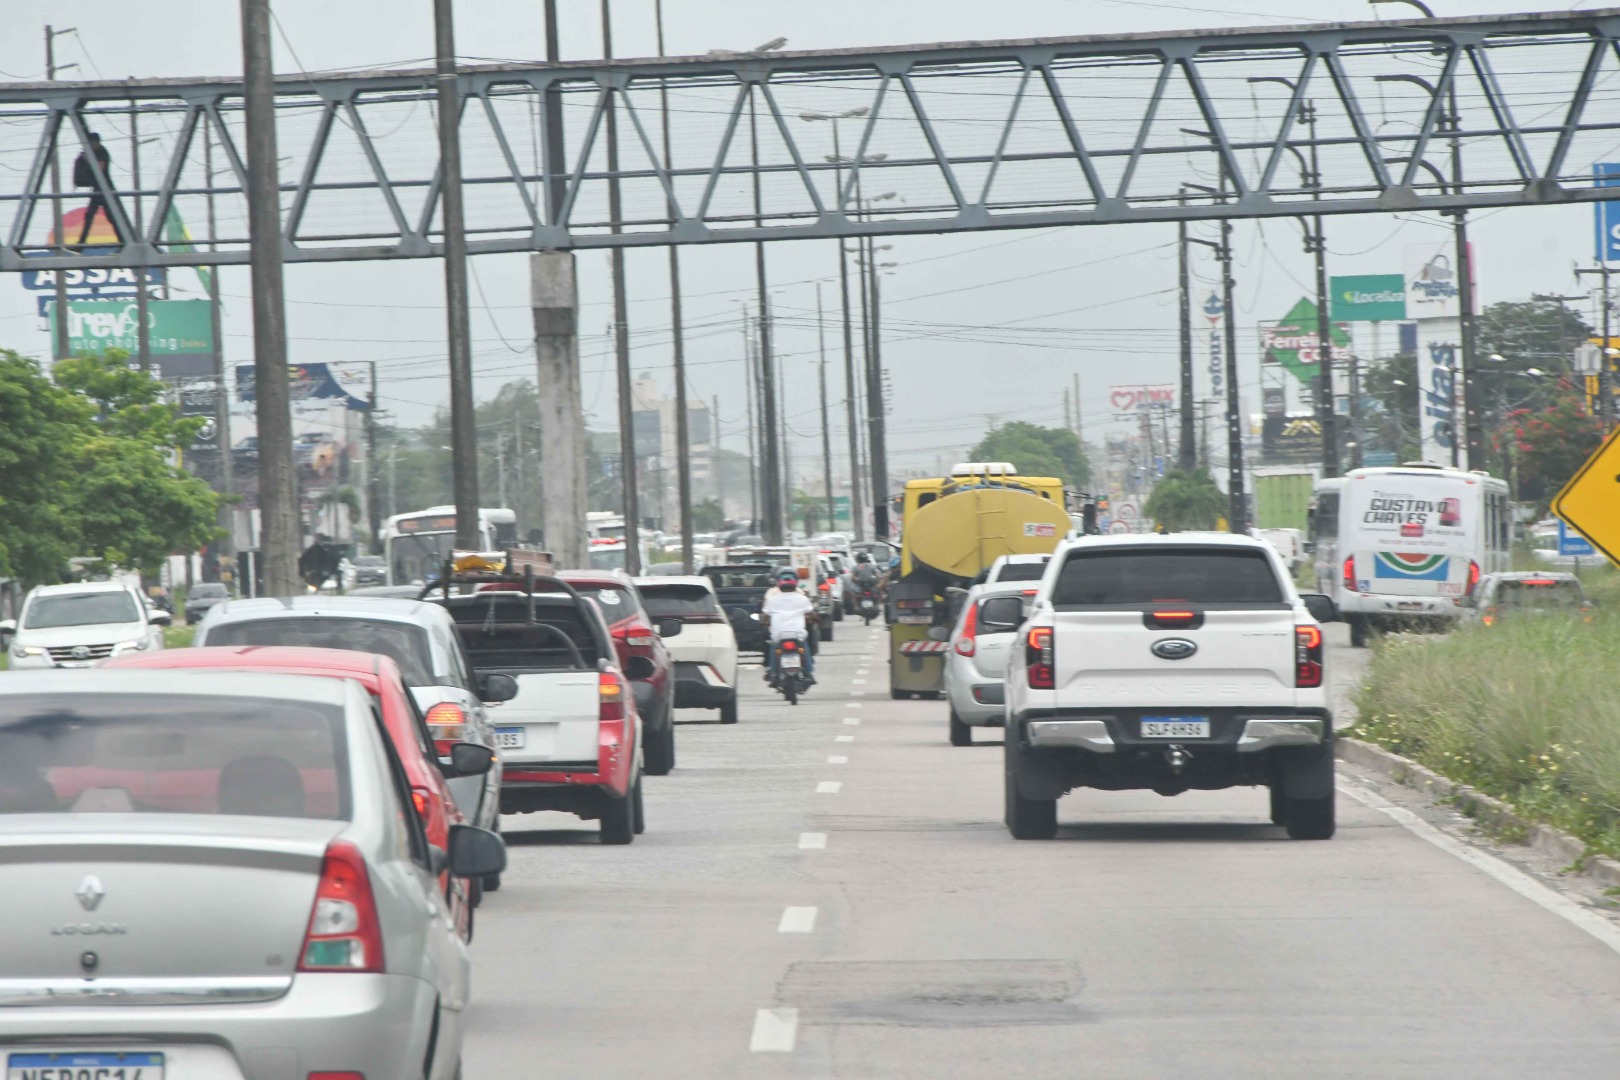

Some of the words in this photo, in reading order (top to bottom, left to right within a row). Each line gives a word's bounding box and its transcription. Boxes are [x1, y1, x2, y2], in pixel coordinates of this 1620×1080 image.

[1370, 499, 1448, 514] GUSTAVO
[1363, 511, 1428, 525] CHAVES
[51, 923, 127, 936] LOGAN
